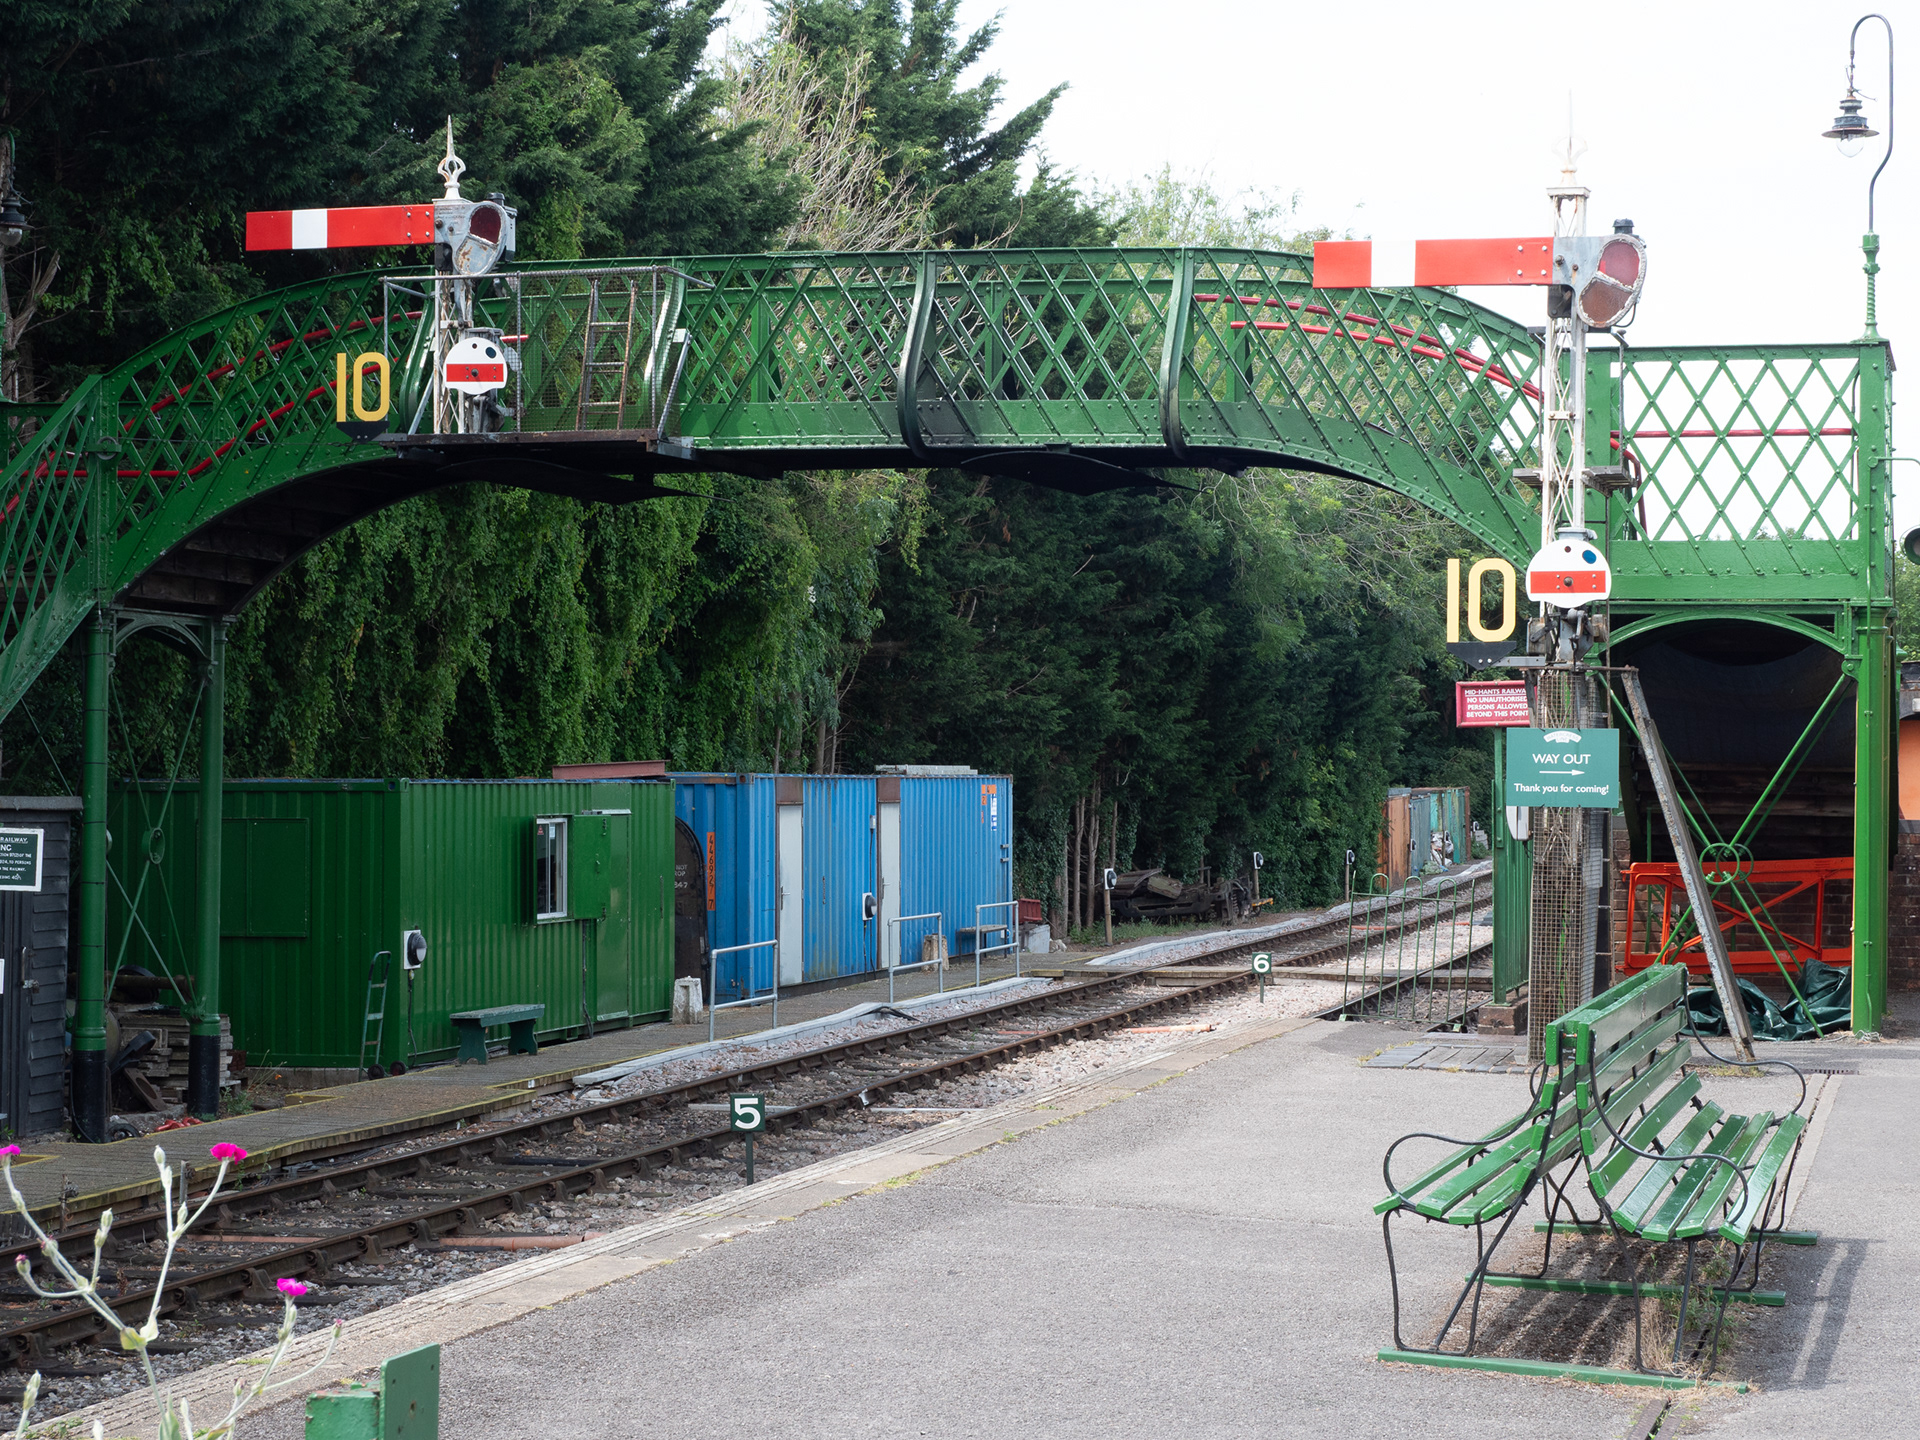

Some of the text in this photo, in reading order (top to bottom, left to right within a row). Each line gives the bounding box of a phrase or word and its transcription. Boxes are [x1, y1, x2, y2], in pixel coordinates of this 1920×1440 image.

[336, 352, 390, 422] 10
[1447, 558, 1516, 643] 10
[1532, 753, 1591, 765] WAY OUT
[1514, 783, 1609, 796] Thank you for coming!
[1254, 954, 1270, 973] 6
[735, 1098, 761, 1129] 5
